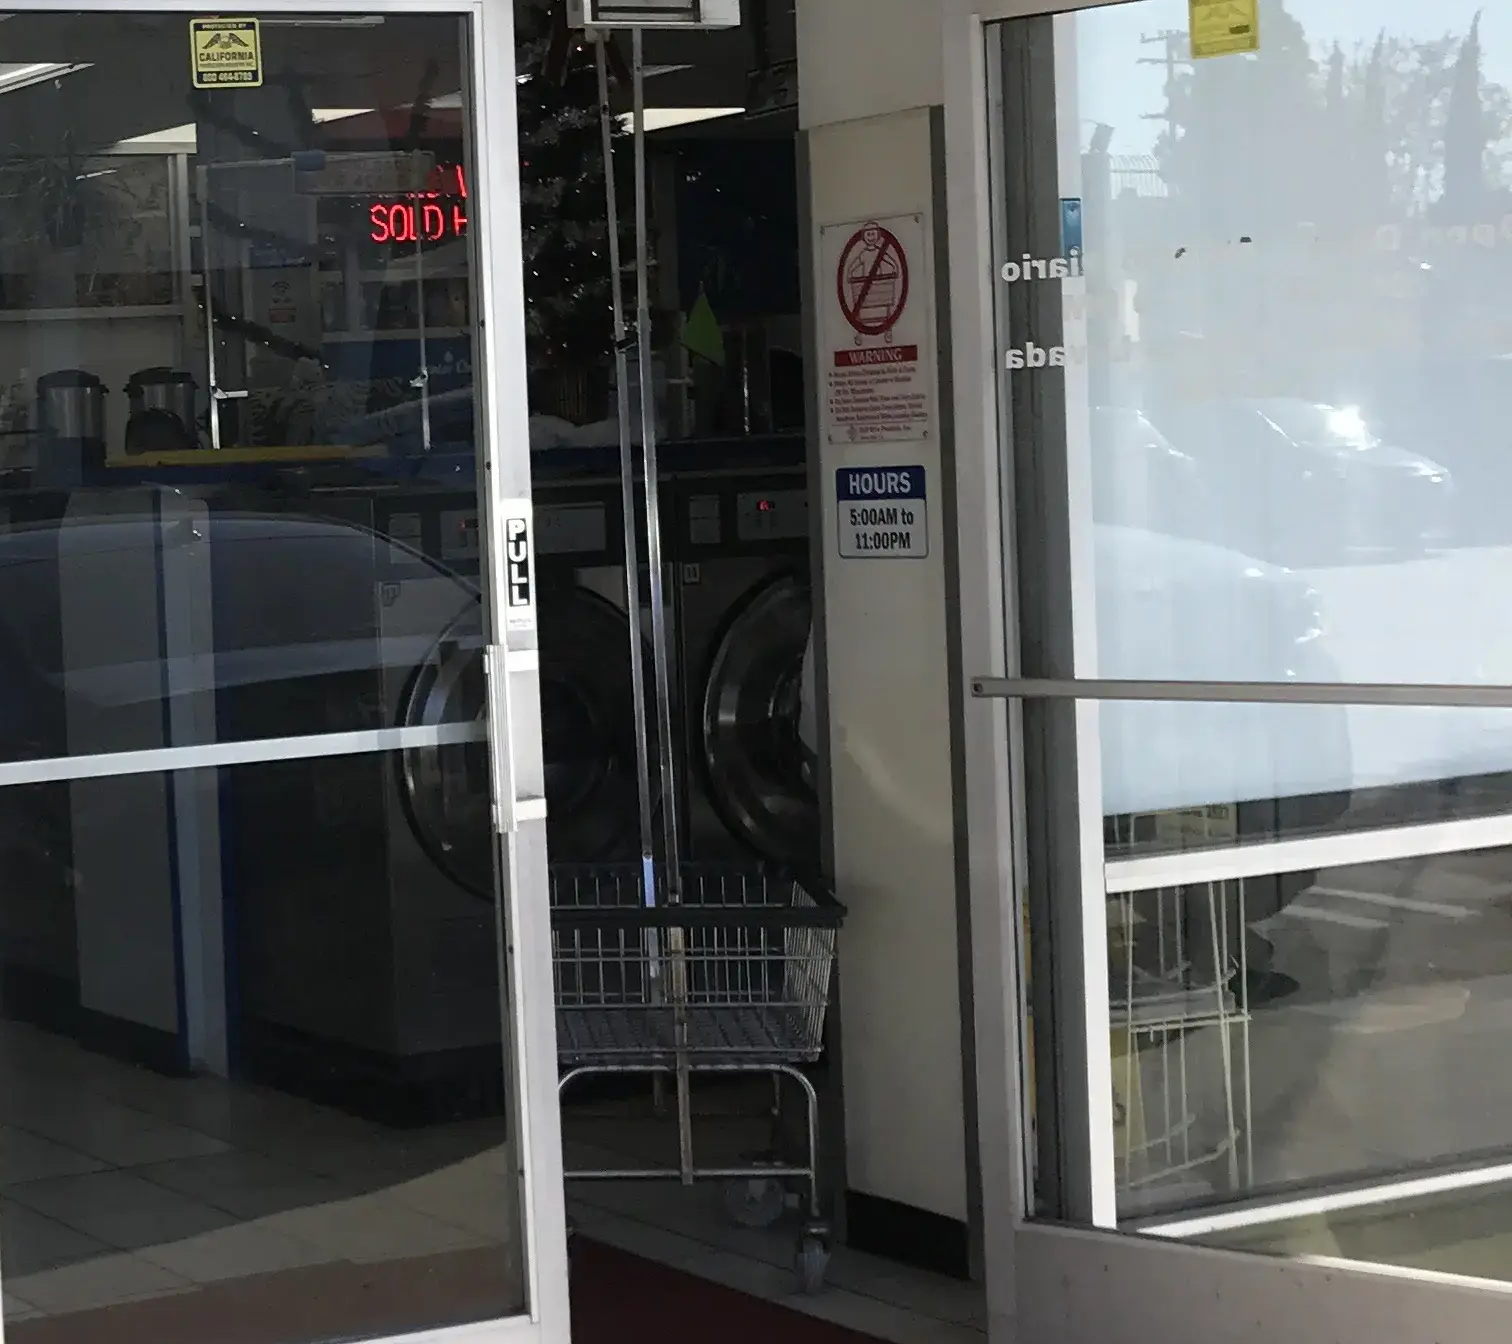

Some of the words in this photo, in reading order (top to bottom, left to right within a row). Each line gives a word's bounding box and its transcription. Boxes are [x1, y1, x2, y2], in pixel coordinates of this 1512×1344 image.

[199, 52, 254, 62] CALIFORNIA
[370, 204, 444, 242] SOLD
[849, 348, 903, 364] WARNING
[849, 472, 911, 495] HOURS
[849, 508, 898, 526] 5:00AM
[901, 508, 914, 525] to
[855, 532, 911, 550] 11:00PM
[508, 519, 528, 606] PULL
